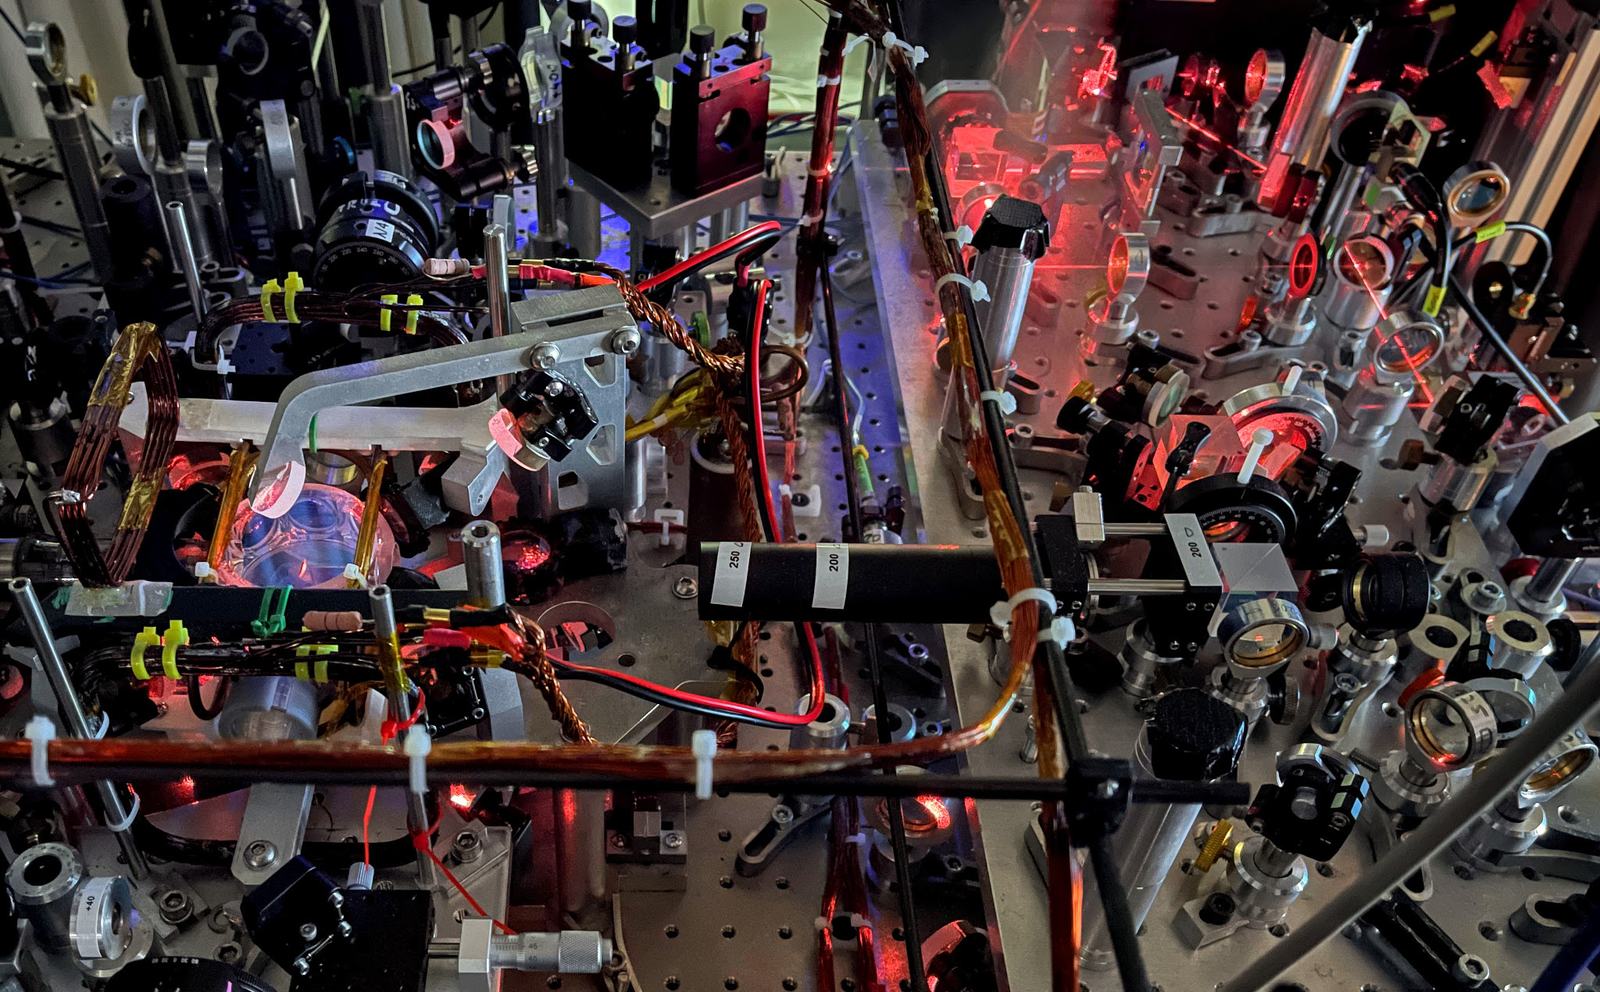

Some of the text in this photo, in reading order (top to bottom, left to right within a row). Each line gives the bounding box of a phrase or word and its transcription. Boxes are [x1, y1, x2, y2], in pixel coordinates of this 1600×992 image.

[1188, 542, 1202, 558] 200
[729, 551, 740, 569] 250
[829, 553, 839, 572] 200
[85, 895, 96, 911] +40
